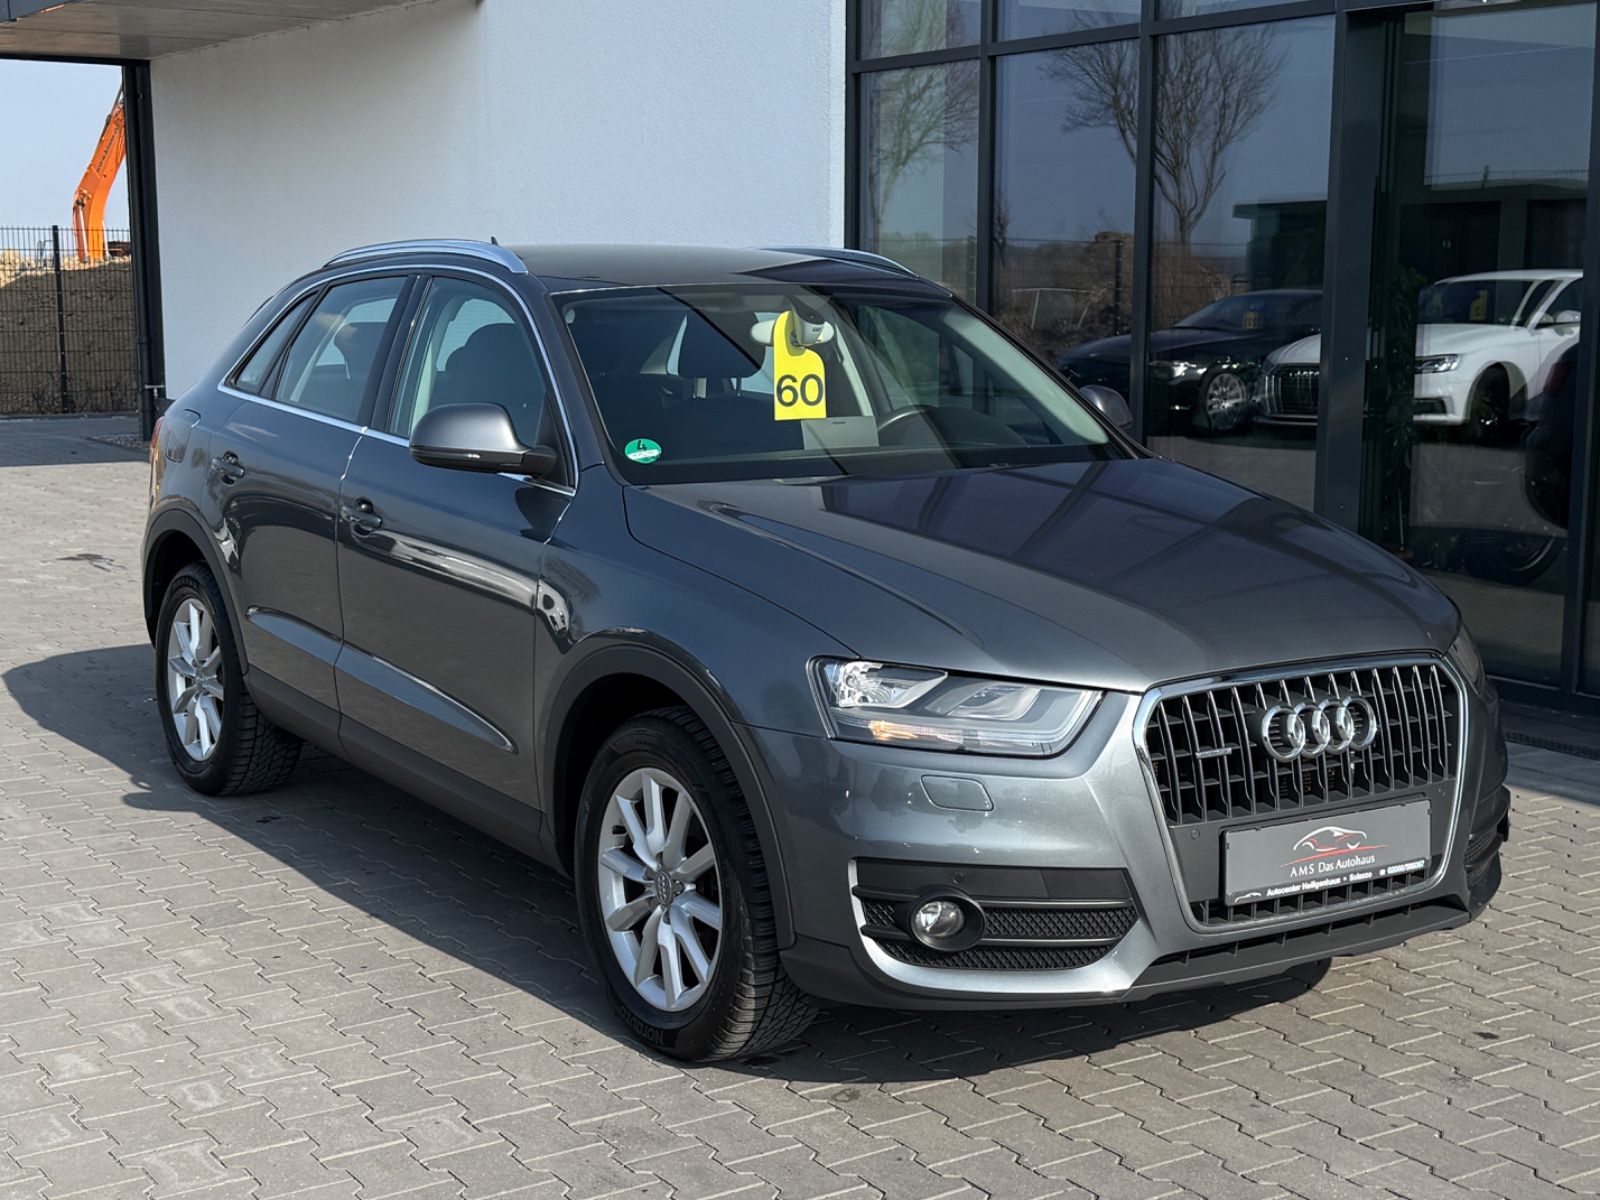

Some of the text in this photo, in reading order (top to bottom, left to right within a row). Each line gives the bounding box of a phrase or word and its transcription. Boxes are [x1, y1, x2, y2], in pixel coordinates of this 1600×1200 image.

[776, 373, 824, 407] 60
[636, 439, 647, 451] 4
[1318, 862, 1334, 873] Das
[1335, 855, 1376, 870] Autohaus
[1301, 878, 1341, 891] Heiligenhaus
